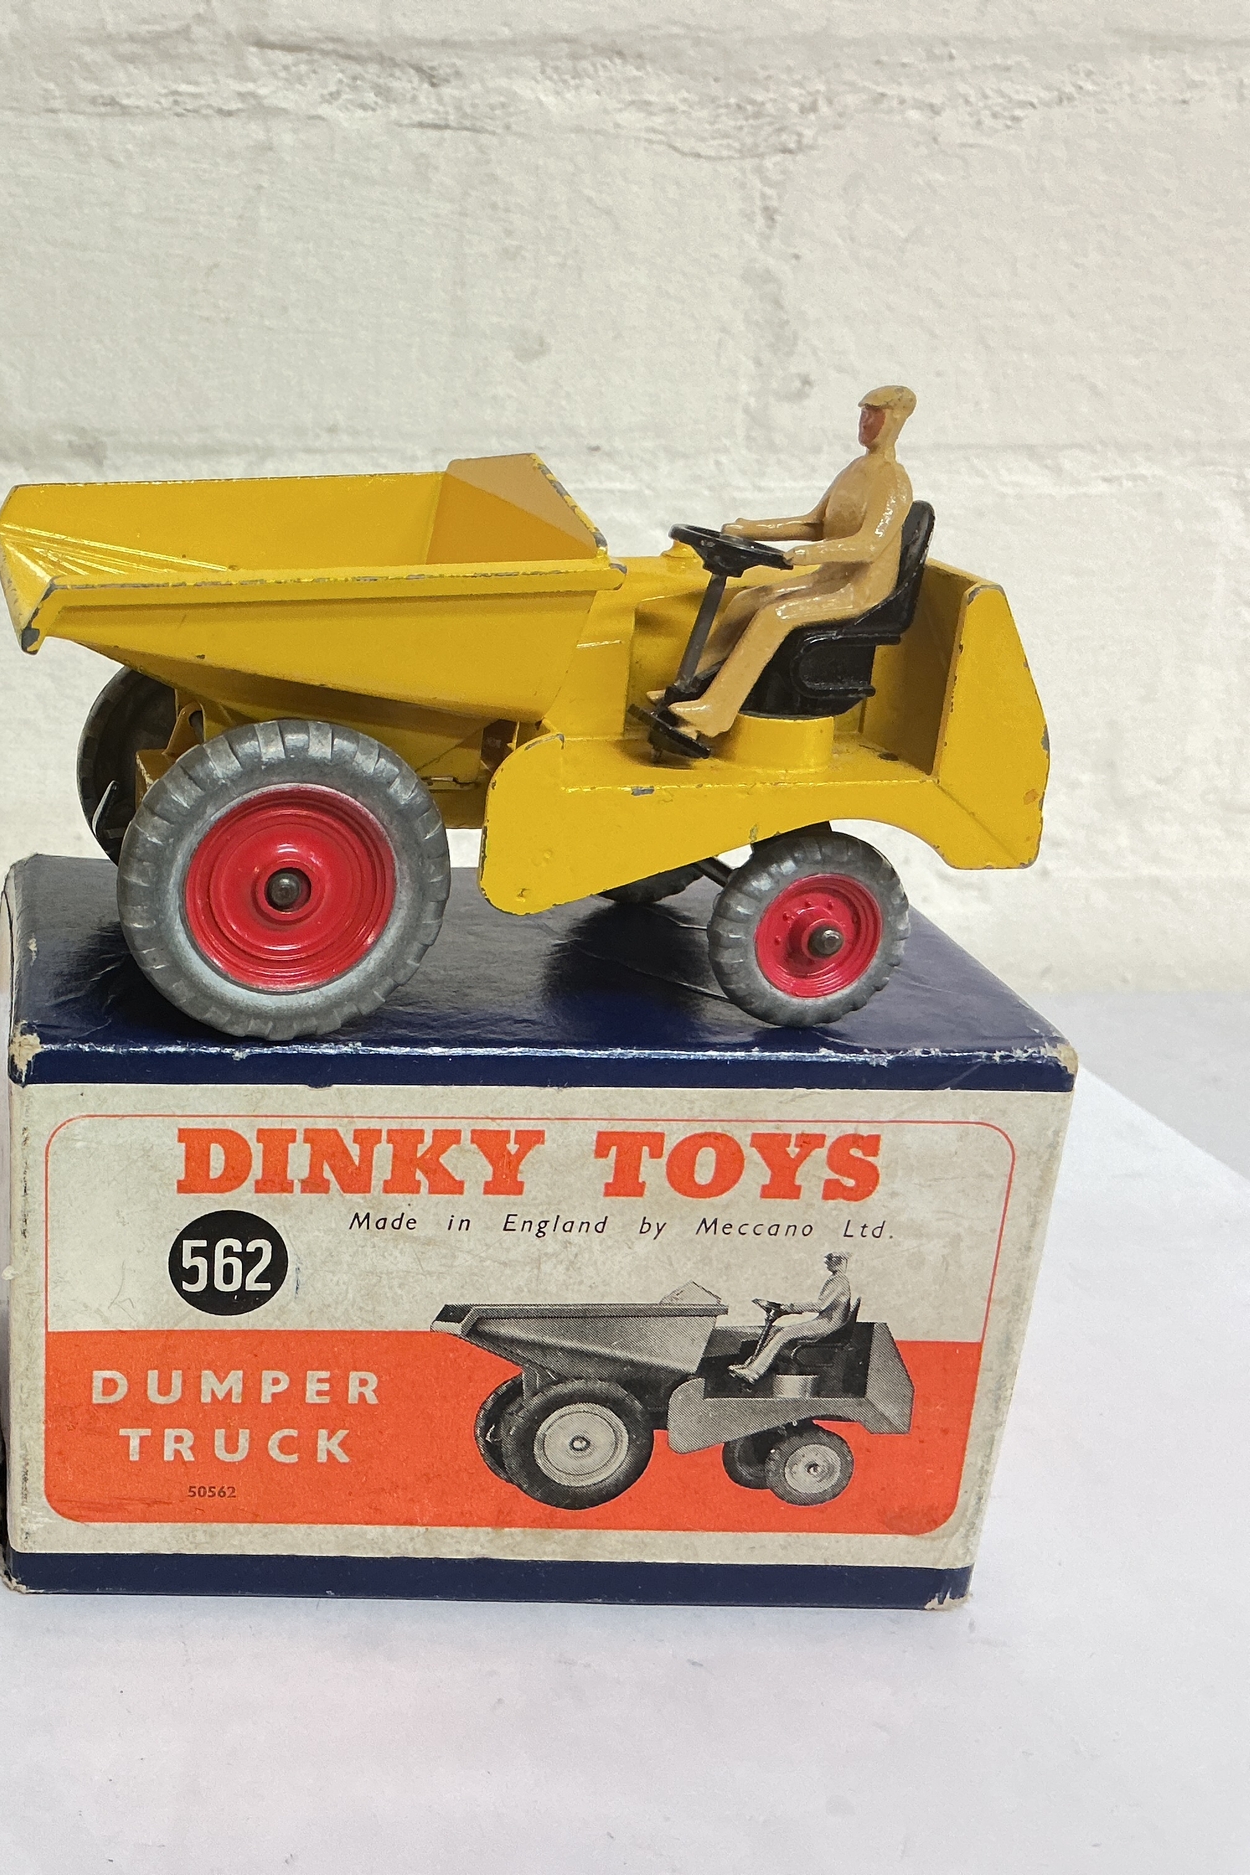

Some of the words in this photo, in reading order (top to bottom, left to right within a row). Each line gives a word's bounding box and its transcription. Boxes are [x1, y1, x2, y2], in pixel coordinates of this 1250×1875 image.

[176, 1127, 546, 1196] DINKY
[594, 1131, 882, 1202] TOYS
[348, 1212, 418, 1231] Made
[447, 1214, 472, 1232] in
[502, 1213, 609, 1239] England
[638, 1216, 667, 1241] by
[695, 1217, 814, 1237] Meccano
[842, 1219, 895, 1240] Ltd.
[180, 1237, 274, 1293] 562
[91, 1369, 379, 1405] DUMPER
[118, 1427, 351, 1464] TRUCK
[187, 1485, 237, 1499] 50562
